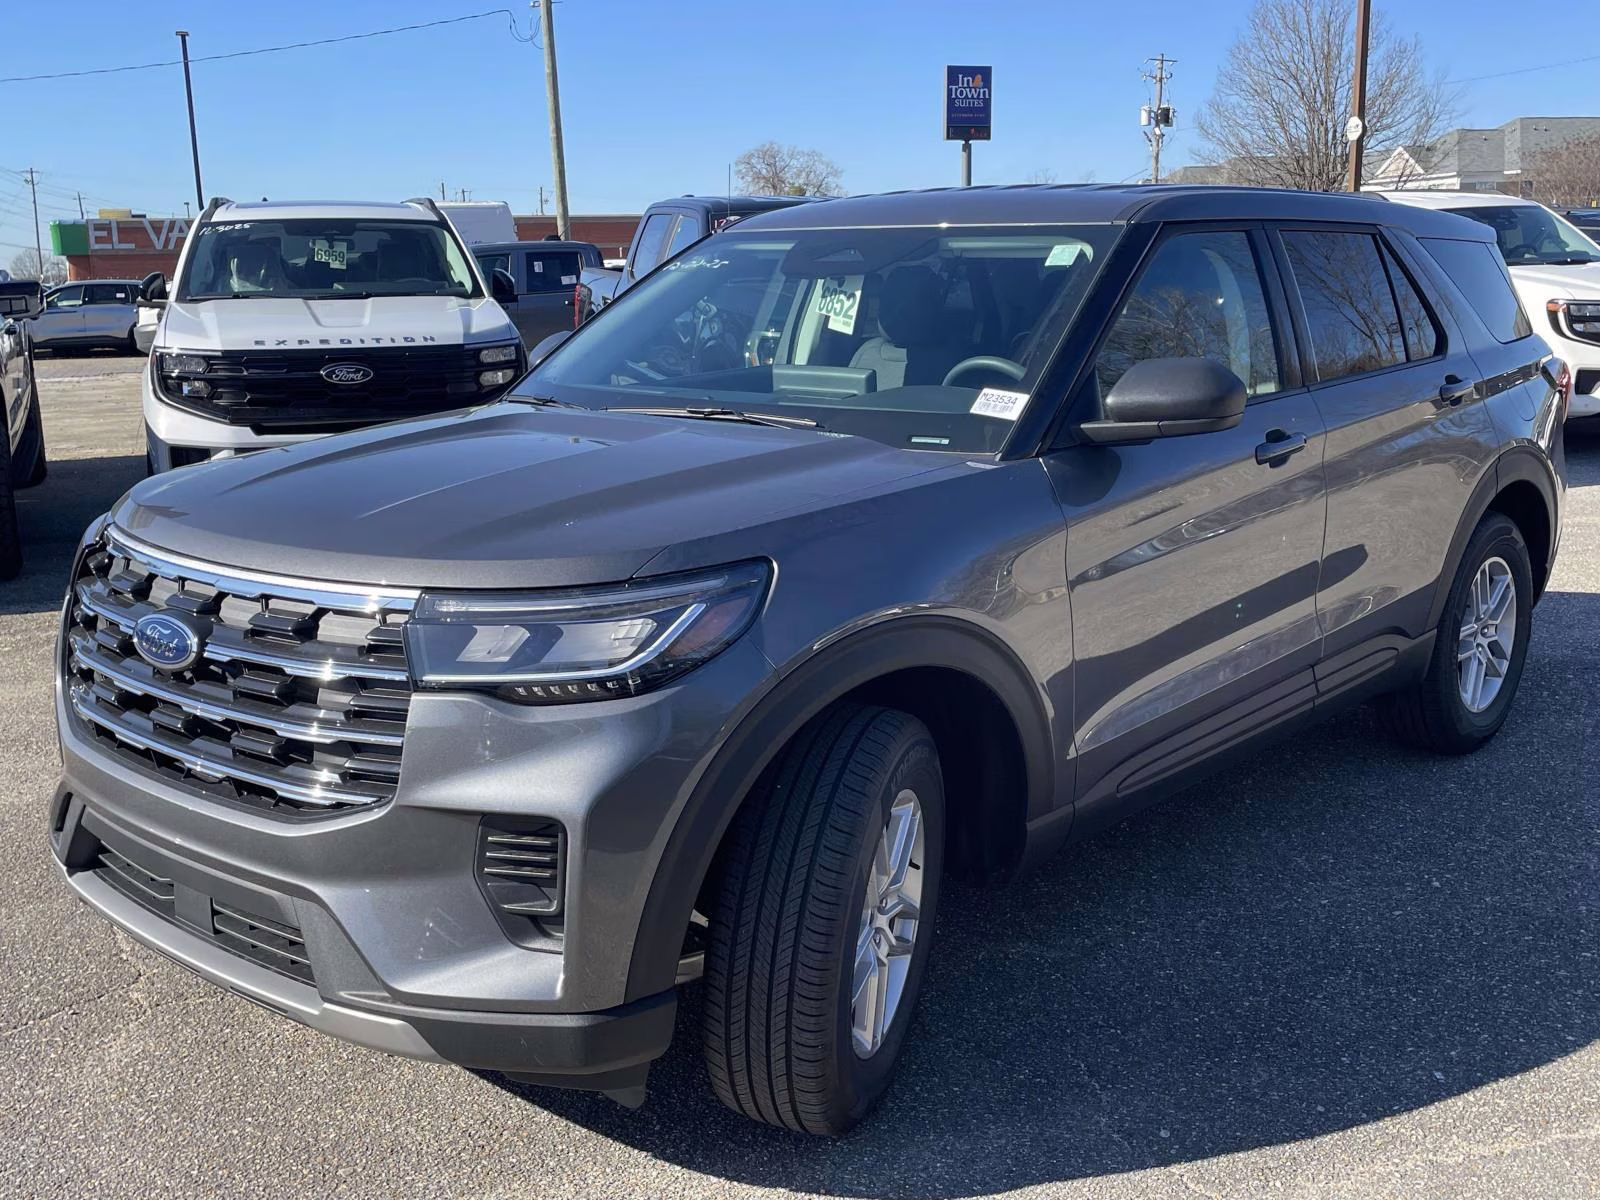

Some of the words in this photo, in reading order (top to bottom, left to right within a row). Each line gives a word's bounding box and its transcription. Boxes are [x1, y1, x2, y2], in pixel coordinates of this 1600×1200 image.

[958, 74, 973, 88] In
[949, 86, 989, 98] Town
[954, 99, 984, 107] SUITES
[88, 220, 136, 250] EL
[316, 249, 345, 263] 6959
[254, 336, 436, 346] EXPEDITION
[332, 368, 363, 381] Ford
[980, 392, 1018, 405] M23534
